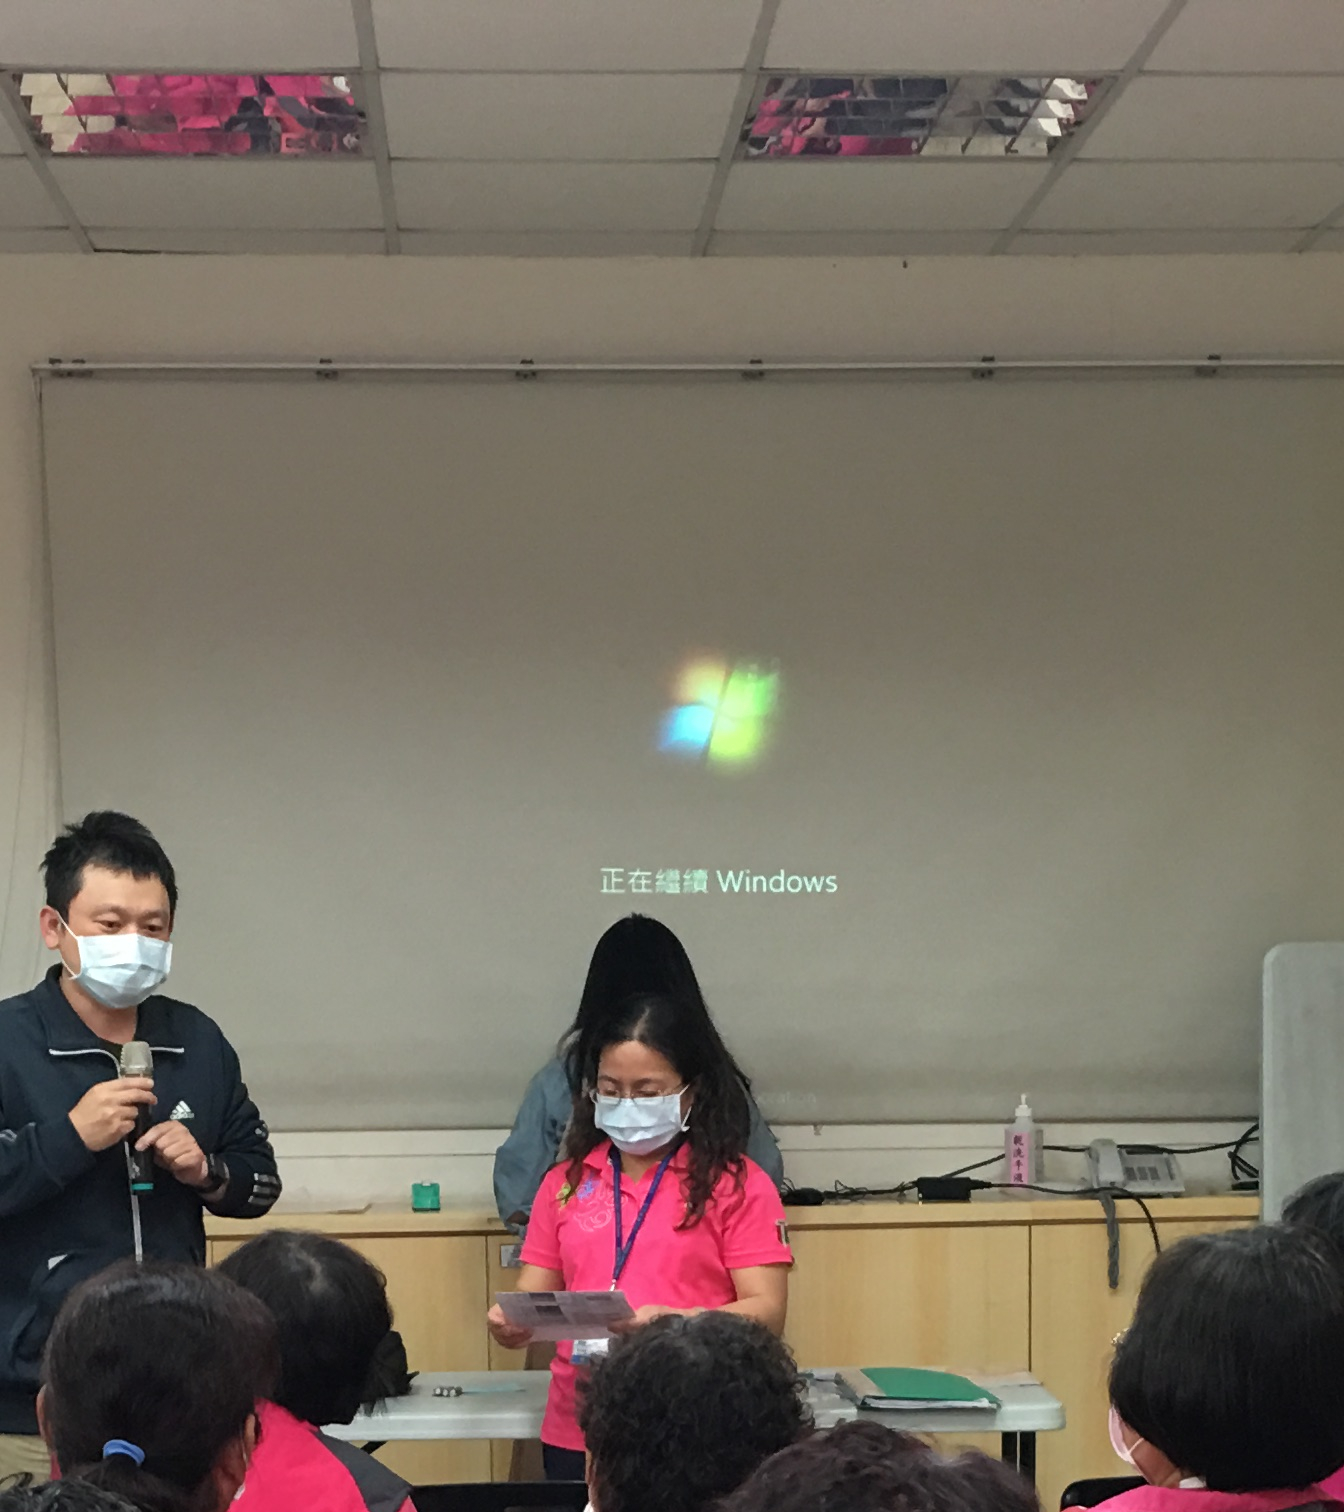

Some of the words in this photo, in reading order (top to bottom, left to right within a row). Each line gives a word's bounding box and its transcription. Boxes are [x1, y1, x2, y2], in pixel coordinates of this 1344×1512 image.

[600, 867, 709, 894] 正在繼續
[716, 869, 838, 893] Windows
